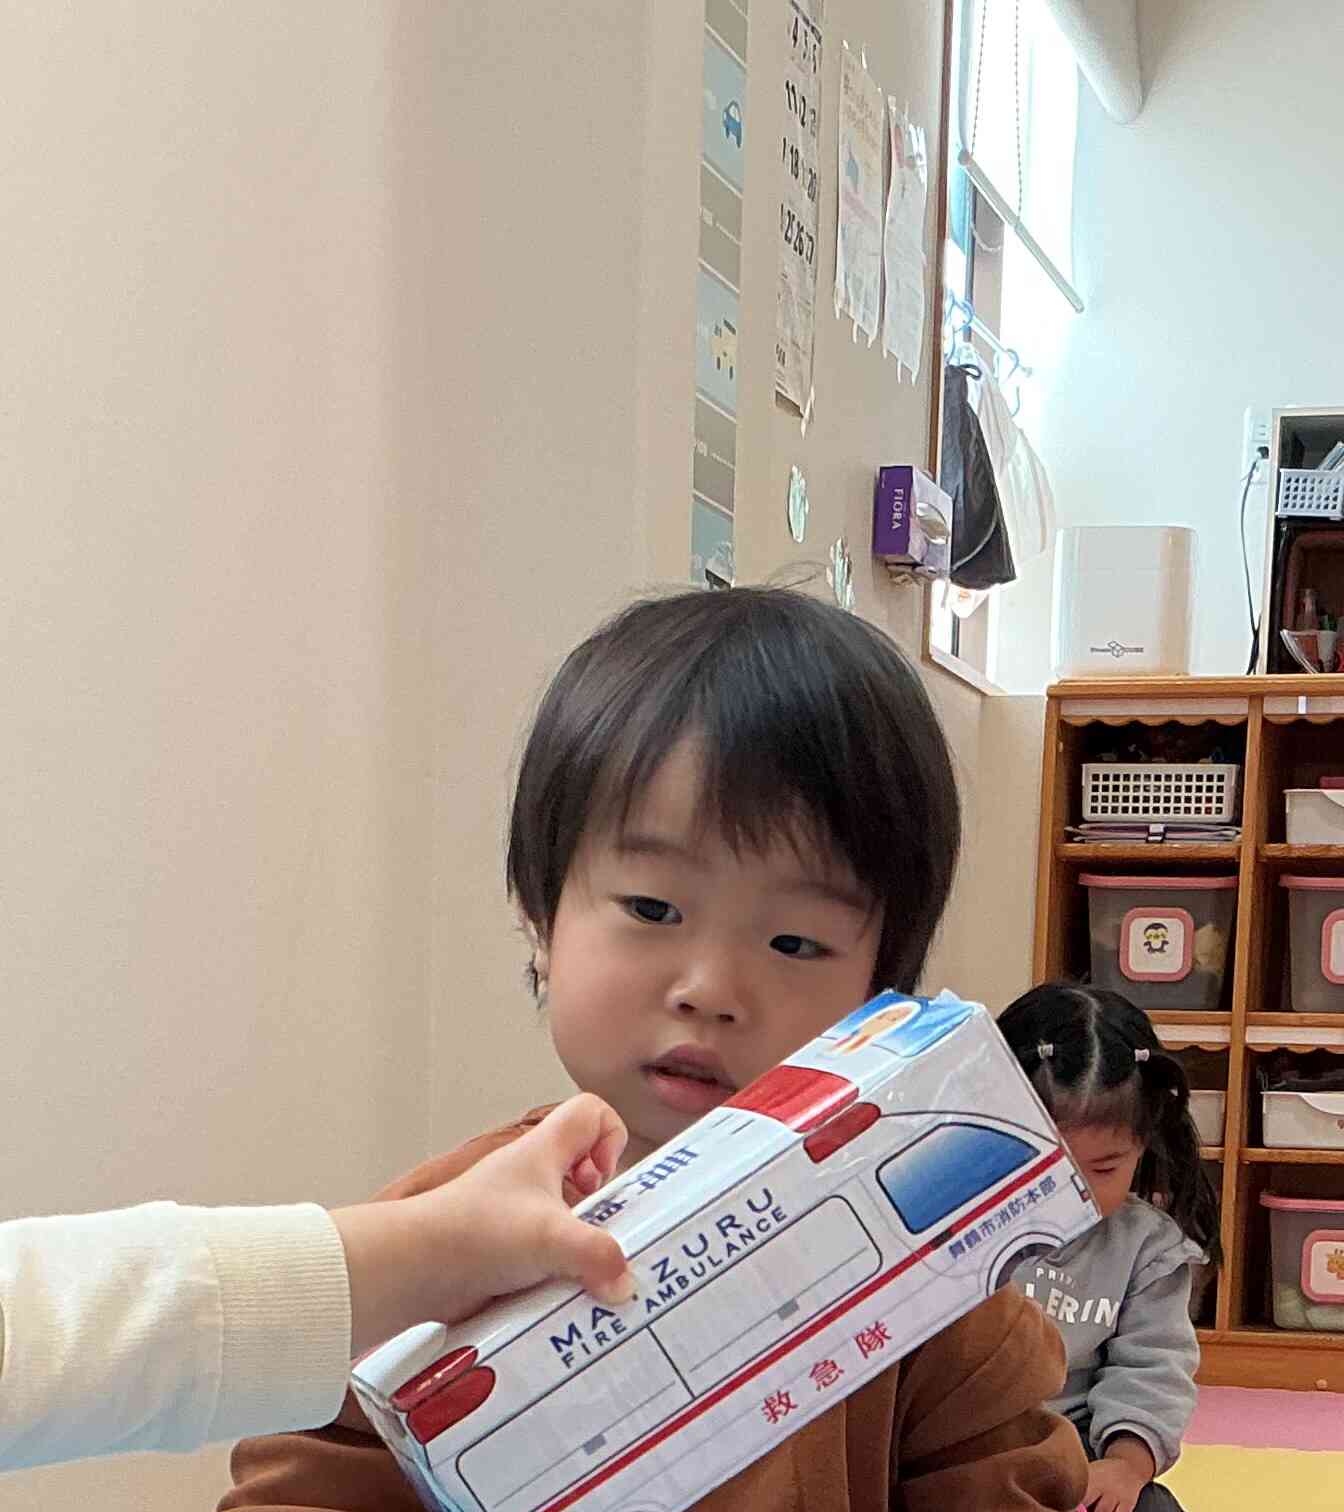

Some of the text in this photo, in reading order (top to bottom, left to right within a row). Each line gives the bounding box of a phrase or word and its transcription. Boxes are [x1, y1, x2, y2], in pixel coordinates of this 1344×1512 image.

[549, 1186, 778, 1353] MAZURU
[559, 1204, 788, 1369] FIRE AMBULANCE
[761, 1320, 892, 1423] 救急隊
